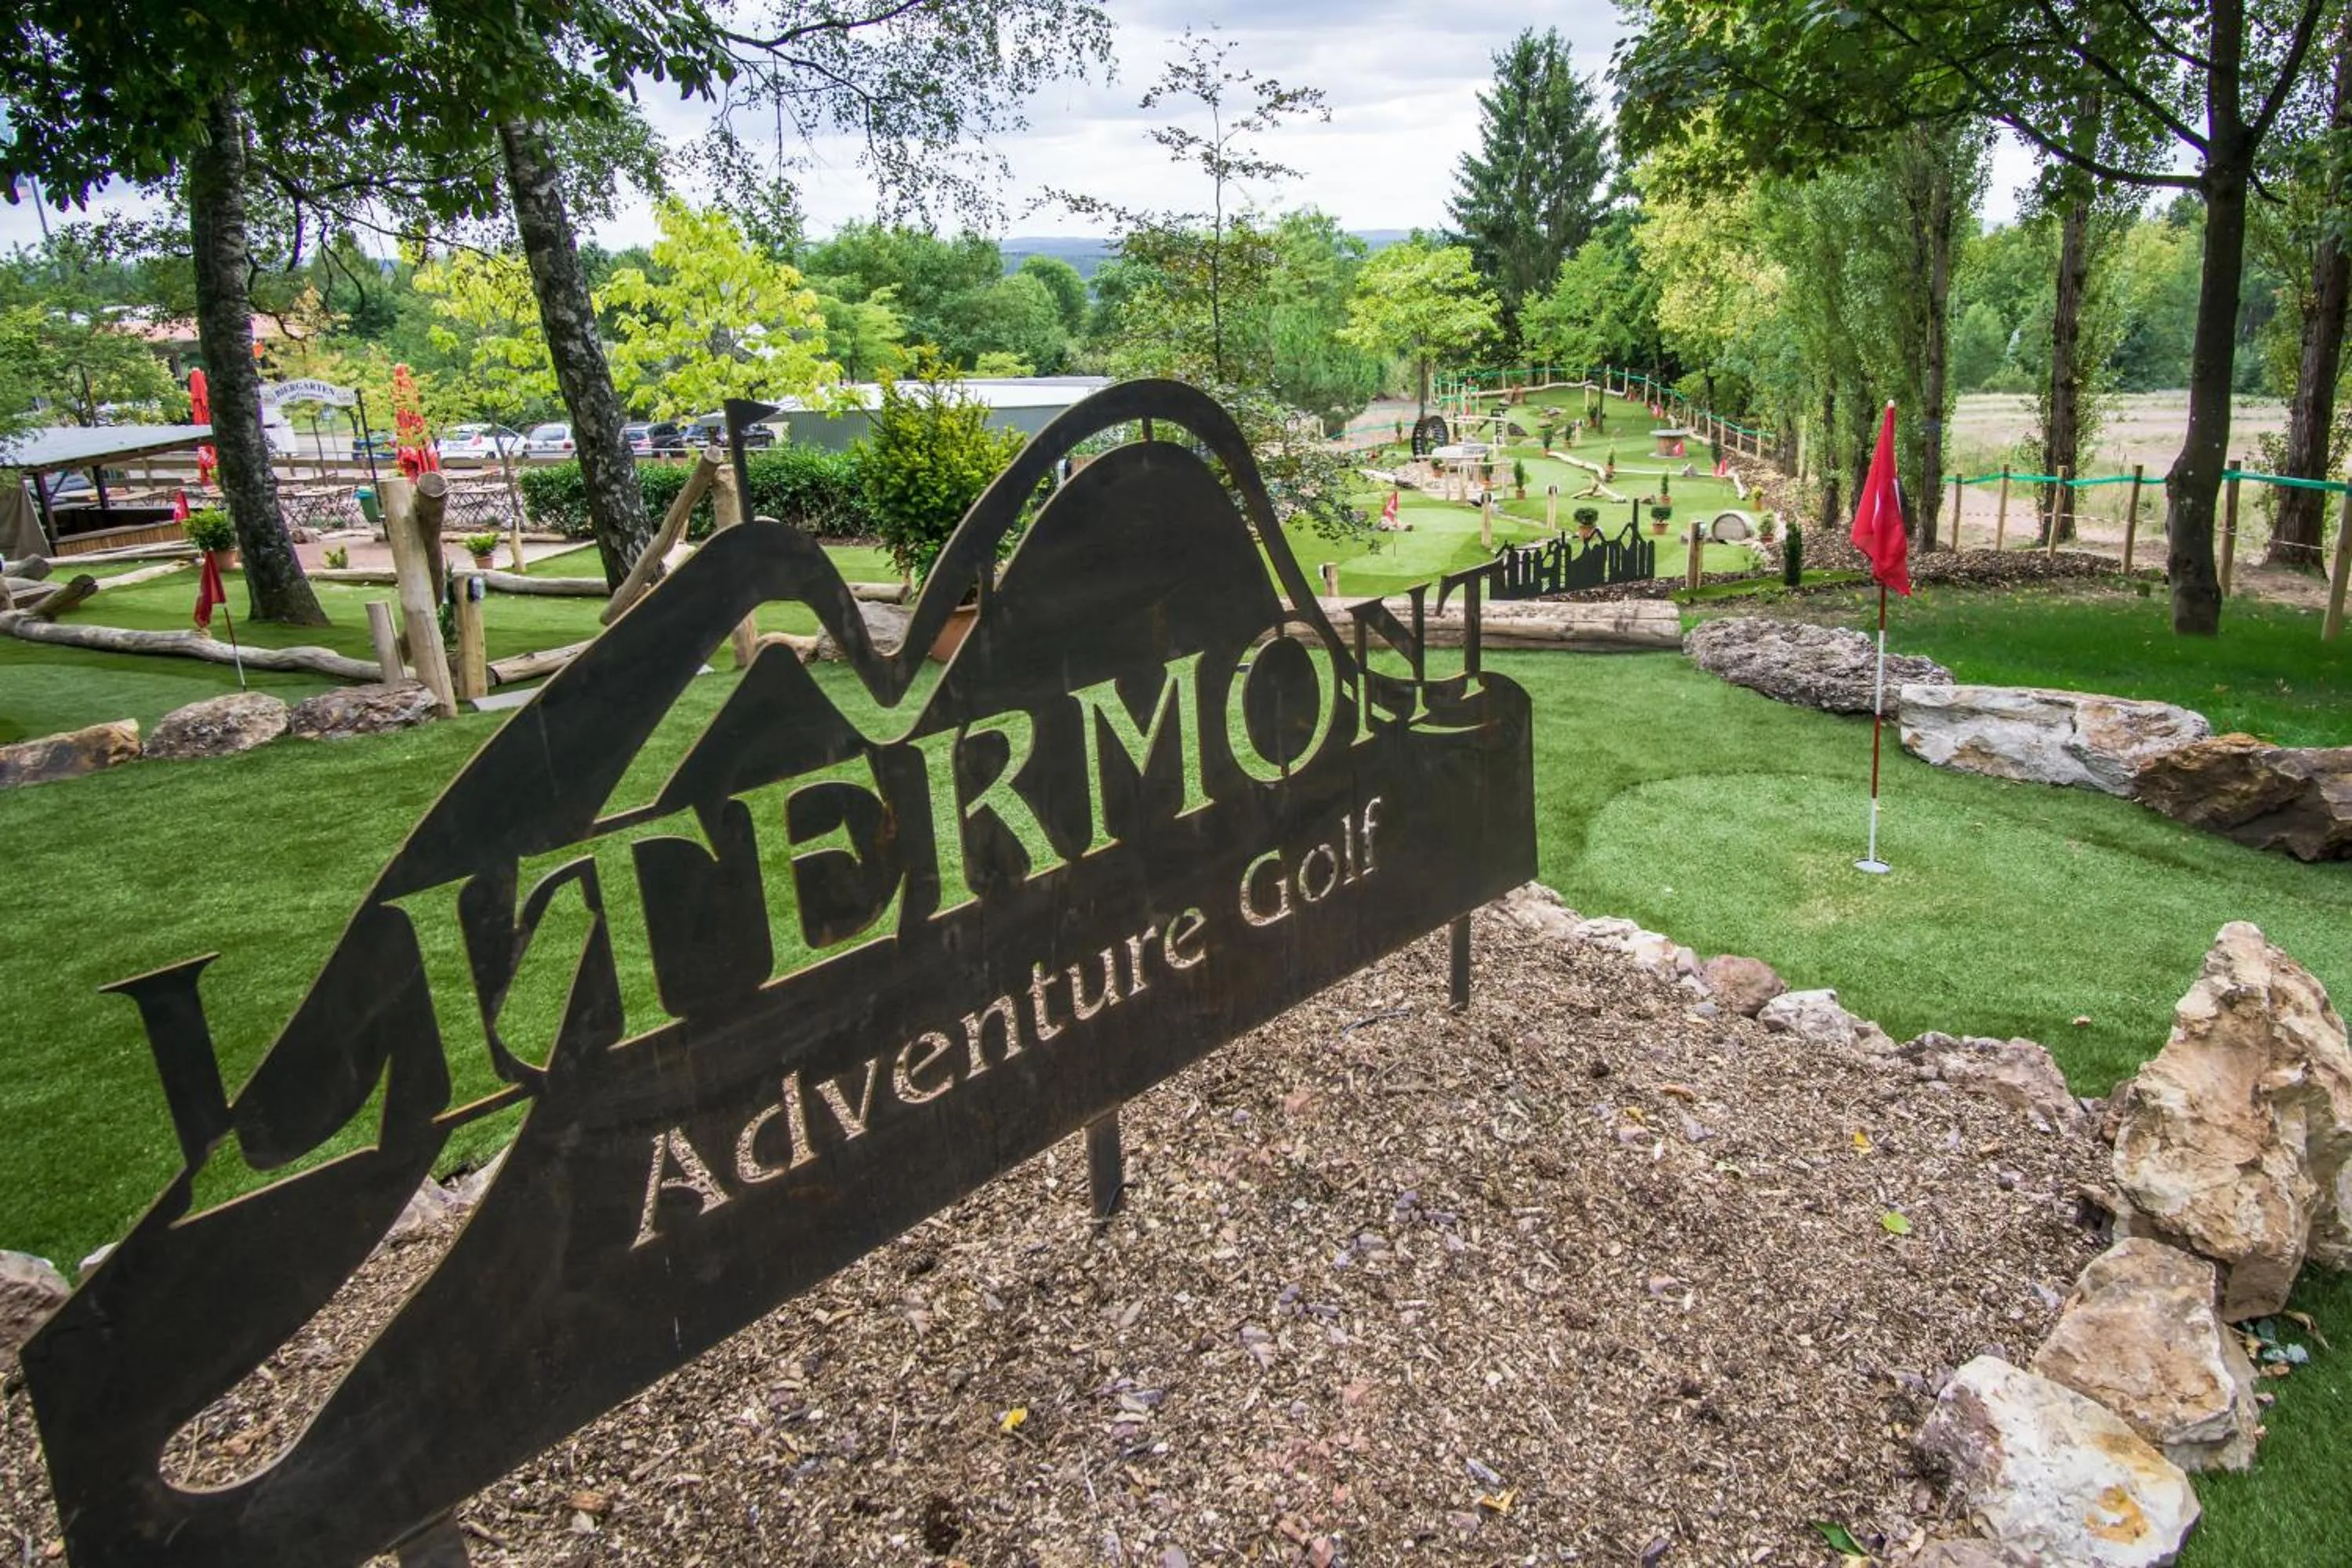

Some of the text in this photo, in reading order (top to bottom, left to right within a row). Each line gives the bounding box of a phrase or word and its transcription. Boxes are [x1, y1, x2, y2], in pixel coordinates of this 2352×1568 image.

[274, 381, 336, 398] BIERGARTEN
[99, 550, 1504, 1229] LITTERMONT
[630, 795, 1383, 1252] Adventure Golf
